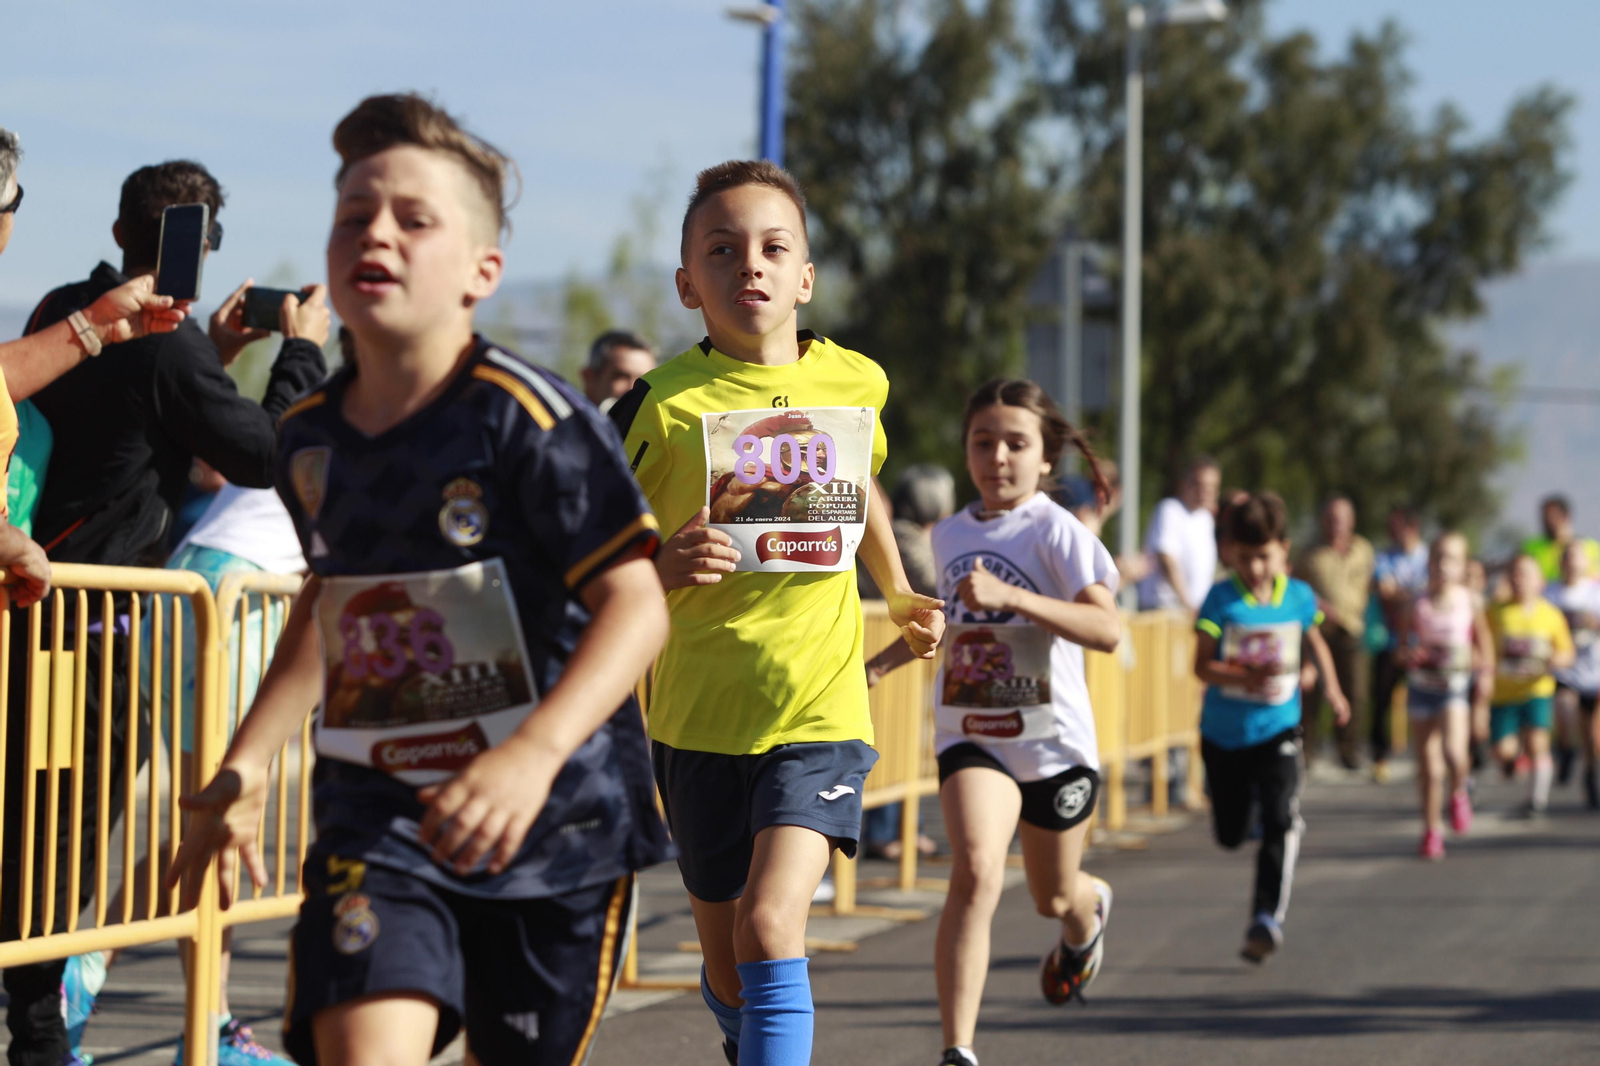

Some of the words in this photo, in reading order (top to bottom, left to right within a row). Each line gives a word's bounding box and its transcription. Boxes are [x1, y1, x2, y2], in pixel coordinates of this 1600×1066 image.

[733, 433, 836, 485] 800
[808, 482, 857, 495] XIII
[339, 608, 455, 680] 836
